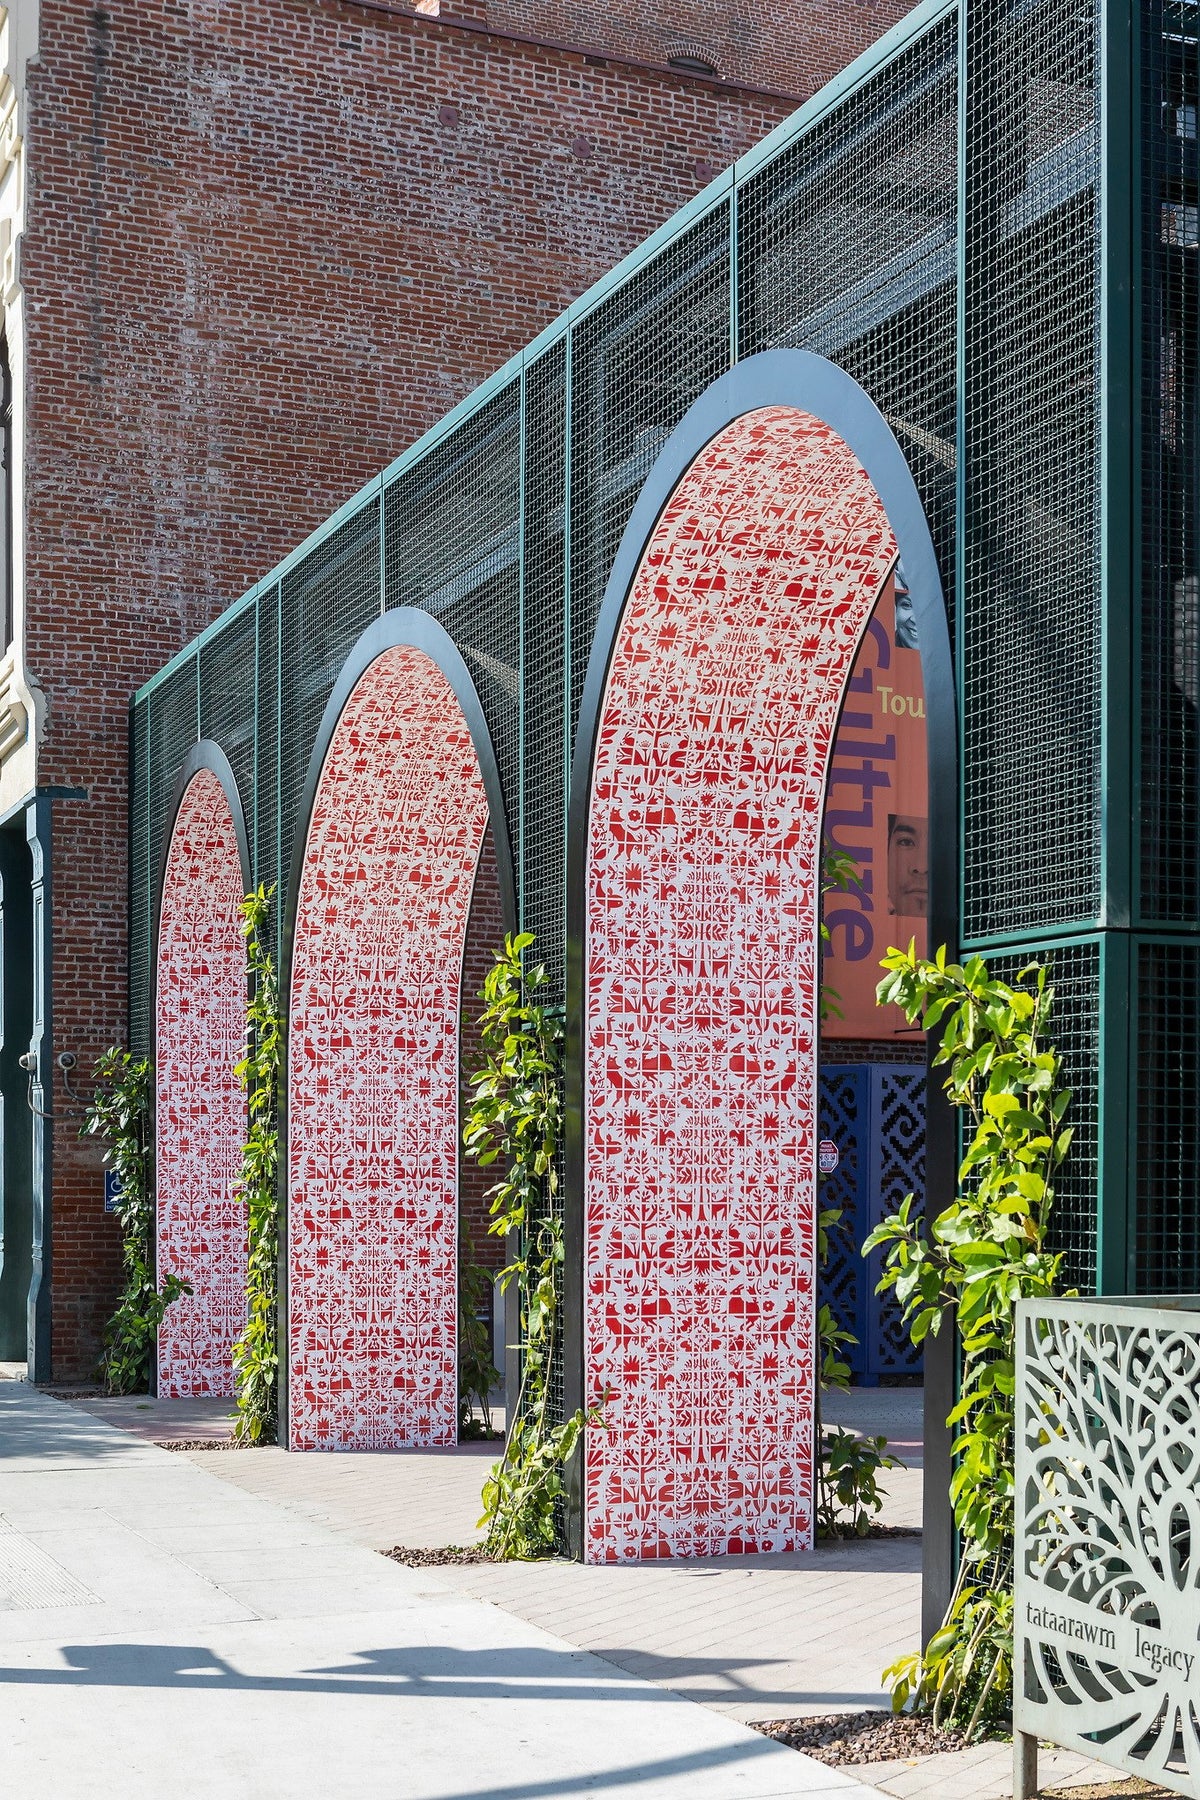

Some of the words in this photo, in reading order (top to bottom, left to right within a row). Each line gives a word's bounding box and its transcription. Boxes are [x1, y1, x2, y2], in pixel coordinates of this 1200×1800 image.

[876, 685, 926, 719] Tou
[1025, 1601, 1117, 1650] tataarawm
[1134, 1627, 1196, 1682] legacy
